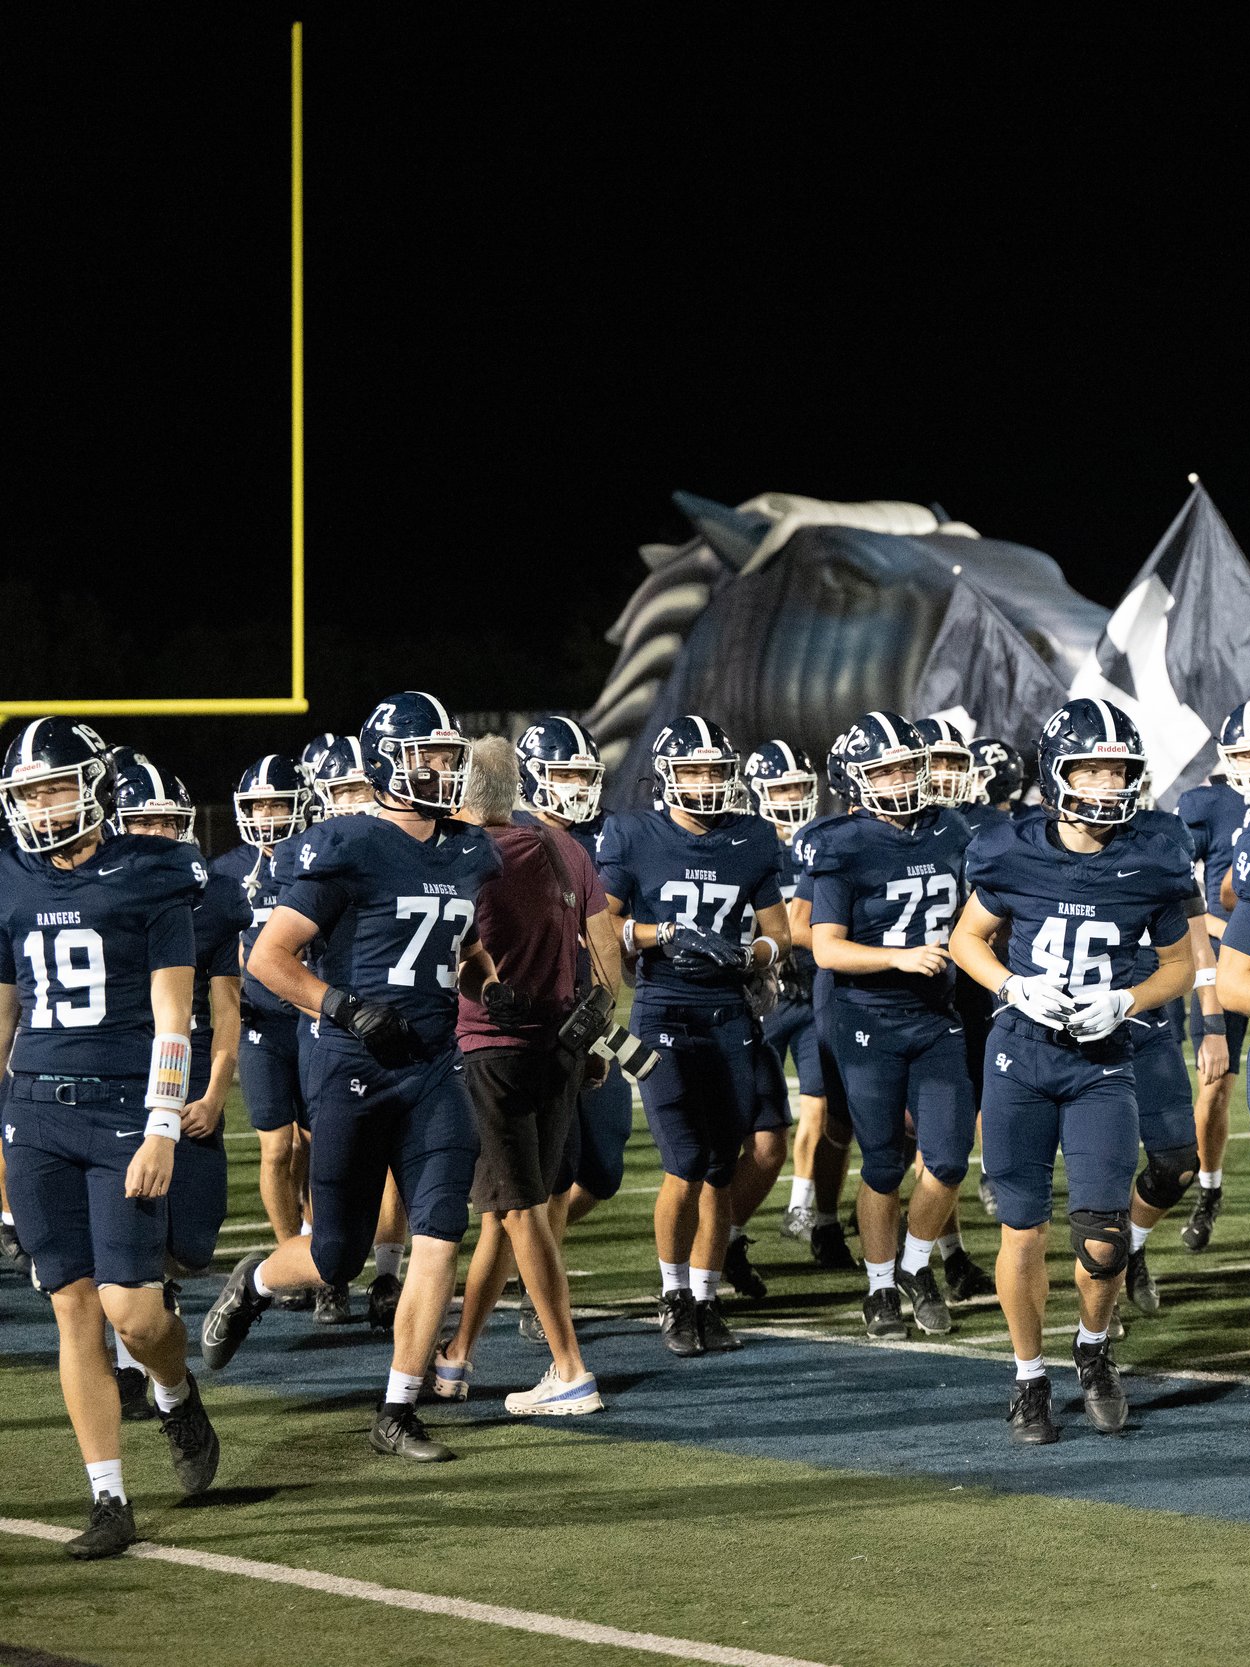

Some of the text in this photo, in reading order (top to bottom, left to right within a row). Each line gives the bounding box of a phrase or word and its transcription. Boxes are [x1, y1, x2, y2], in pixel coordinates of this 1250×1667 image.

[366, 703, 397, 731] 73
[71, 724, 107, 753] 19
[979, 743, 1009, 766] 25
[1097, 745, 1127, 753] Riddell
[300, 843, 317, 870] SV
[803, 843, 817, 866] SV
[685, 868, 717, 881] RANGERS
[906, 863, 937, 877] RANGERS
[422, 882, 458, 896] RANGERS
[660, 880, 740, 936] 37
[883, 873, 957, 946] 72
[1058, 901, 1096, 917] RANGERS
[37, 911, 81, 926] RANGERS
[387, 896, 475, 989] 73
[1031, 916, 1121, 997] 46
[23, 928, 106, 1028] 19
[249, 1029, 262, 1044] SV
[659, 1033, 675, 1047] SV
[855, 1030, 870, 1047] SV
[995, 1052, 1013, 1072] SV
[350, 1078, 368, 1097] SV
